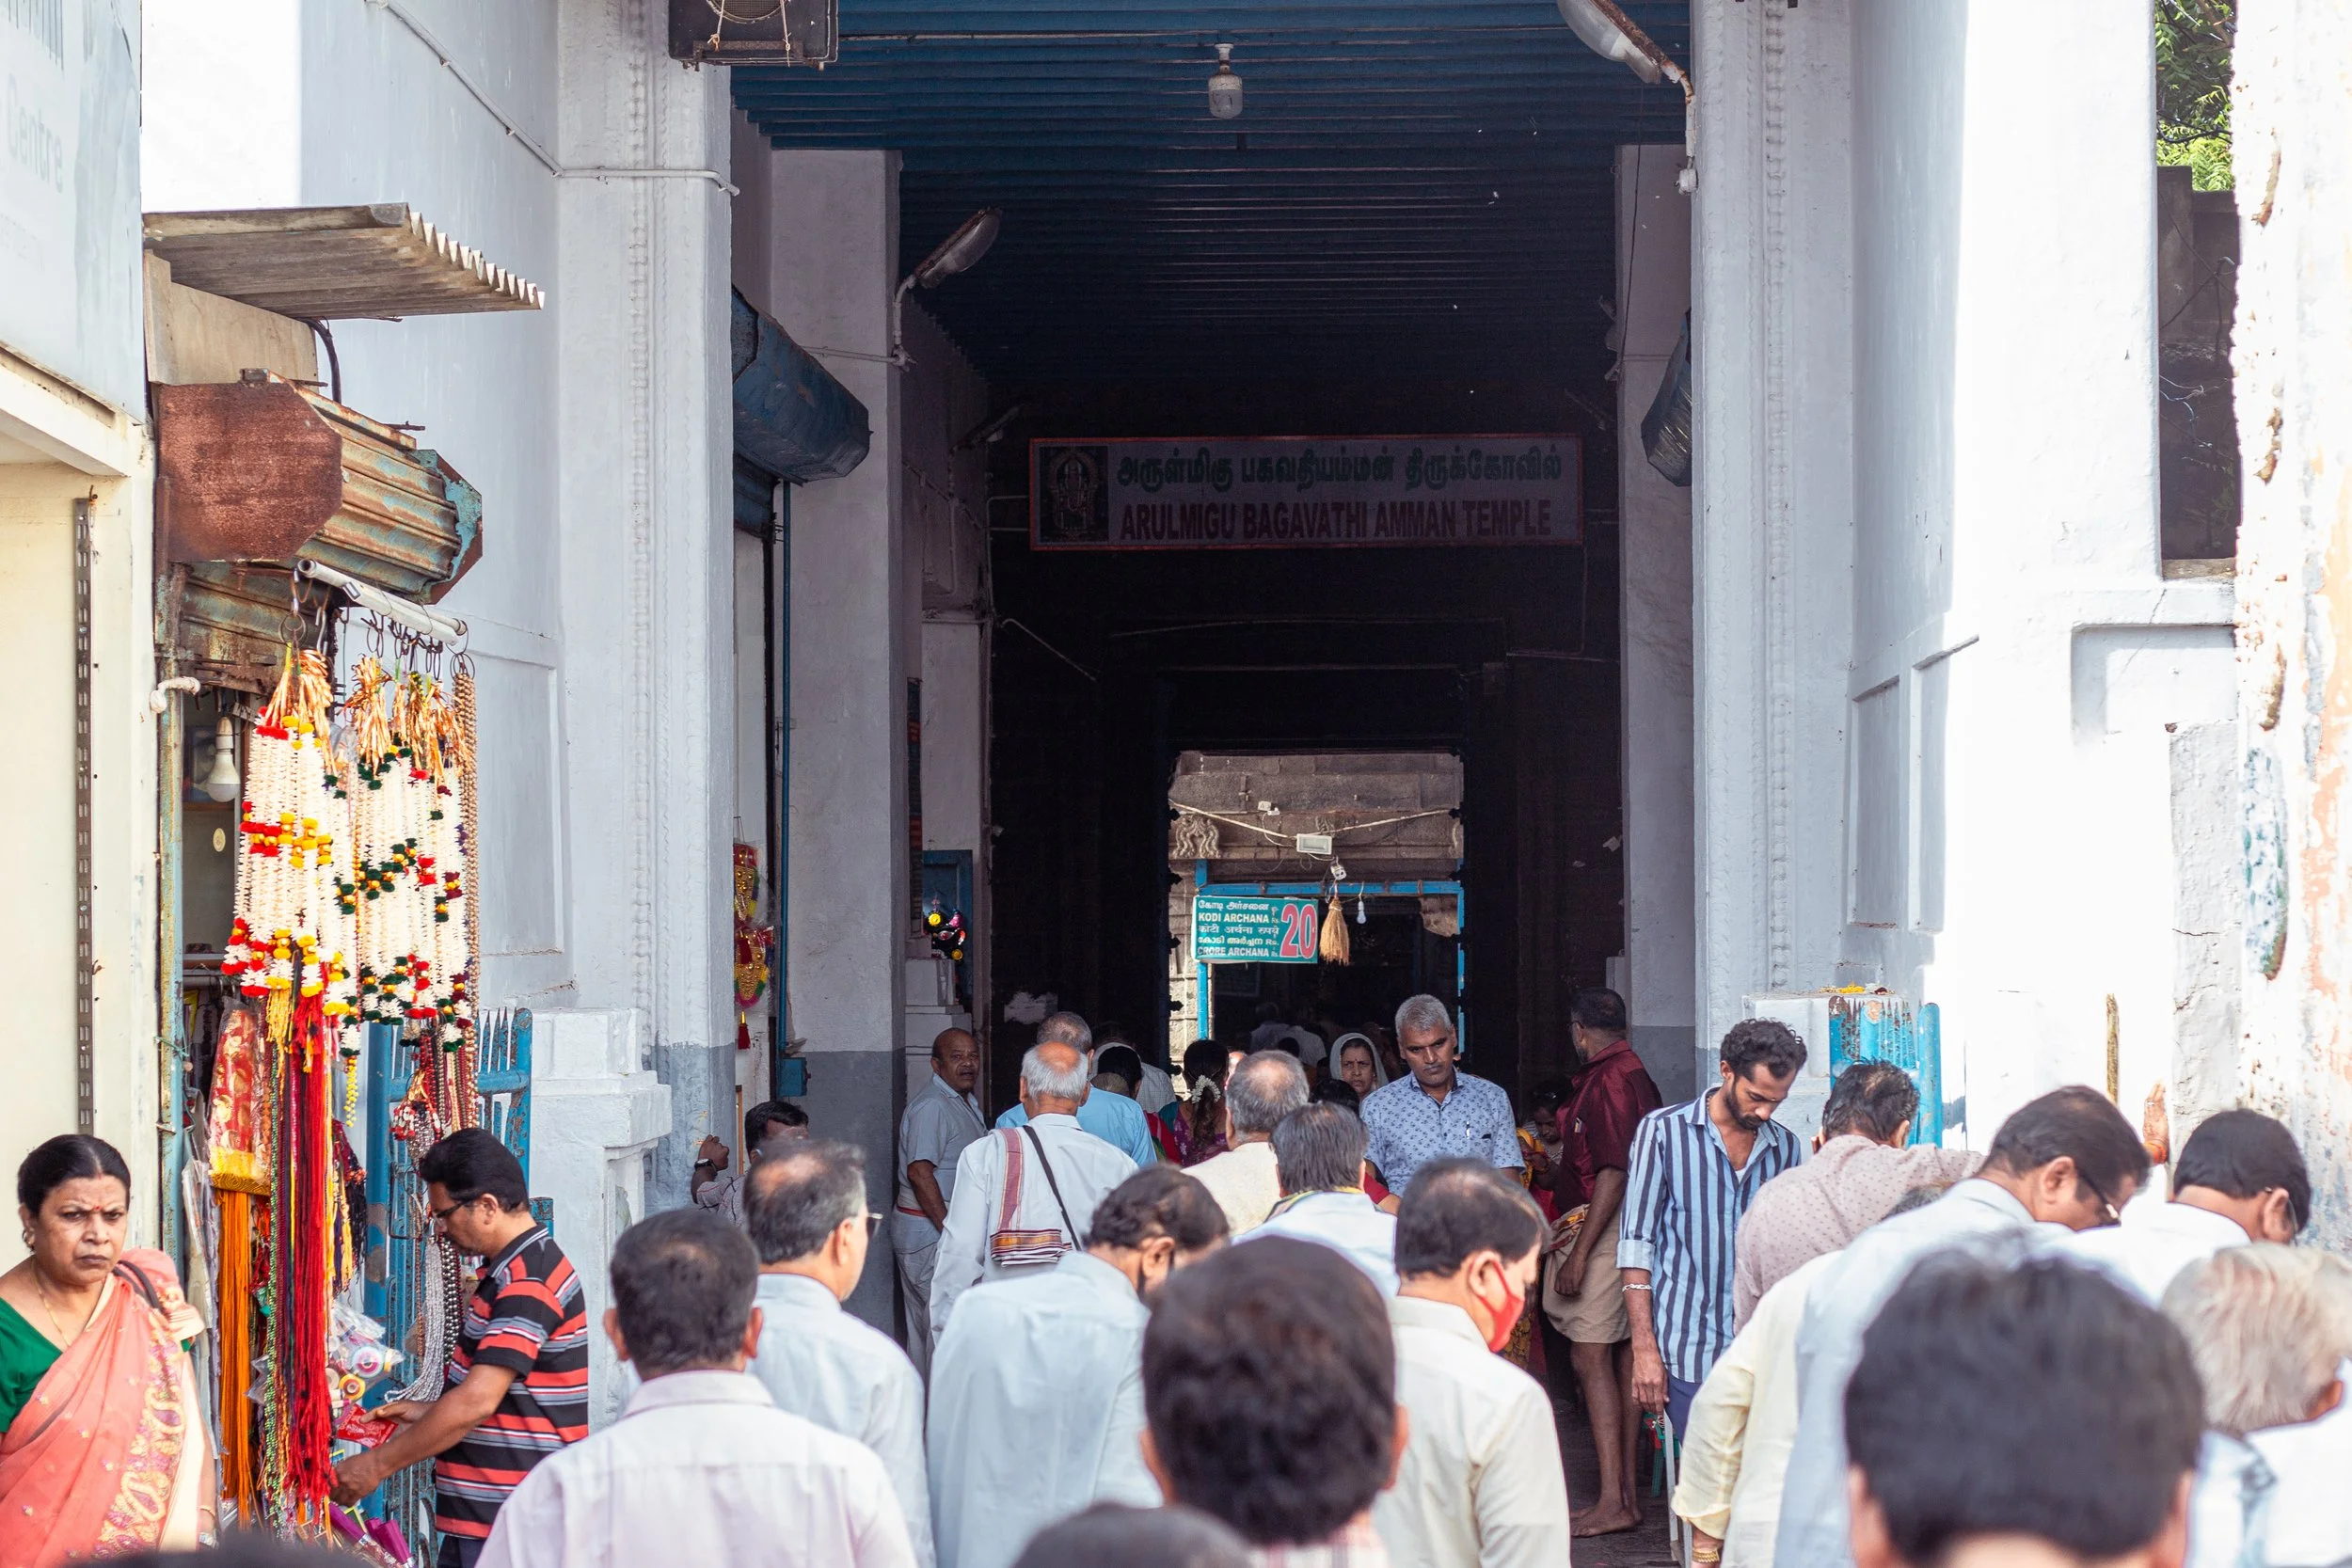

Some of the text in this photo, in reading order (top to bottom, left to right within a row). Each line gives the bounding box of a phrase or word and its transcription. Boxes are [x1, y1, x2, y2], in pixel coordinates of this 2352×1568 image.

[8, 71, 64, 194] Centre
[1118, 447, 1232, 493] அருள்மிகு
[1121, 499, 1552, 540] ARULMIGU BAGAVATHI AMMAN TEMPLE
[1198, 912, 1222, 922] KODI
[1223, 913, 1270, 924] ARCHANA
[1224, 924, 1253, 934] अर्चना
[1280, 903, 1317, 958] 20
[1198, 946, 1226, 956] CRORE
[1228, 947, 1269, 957] ARCHANA
